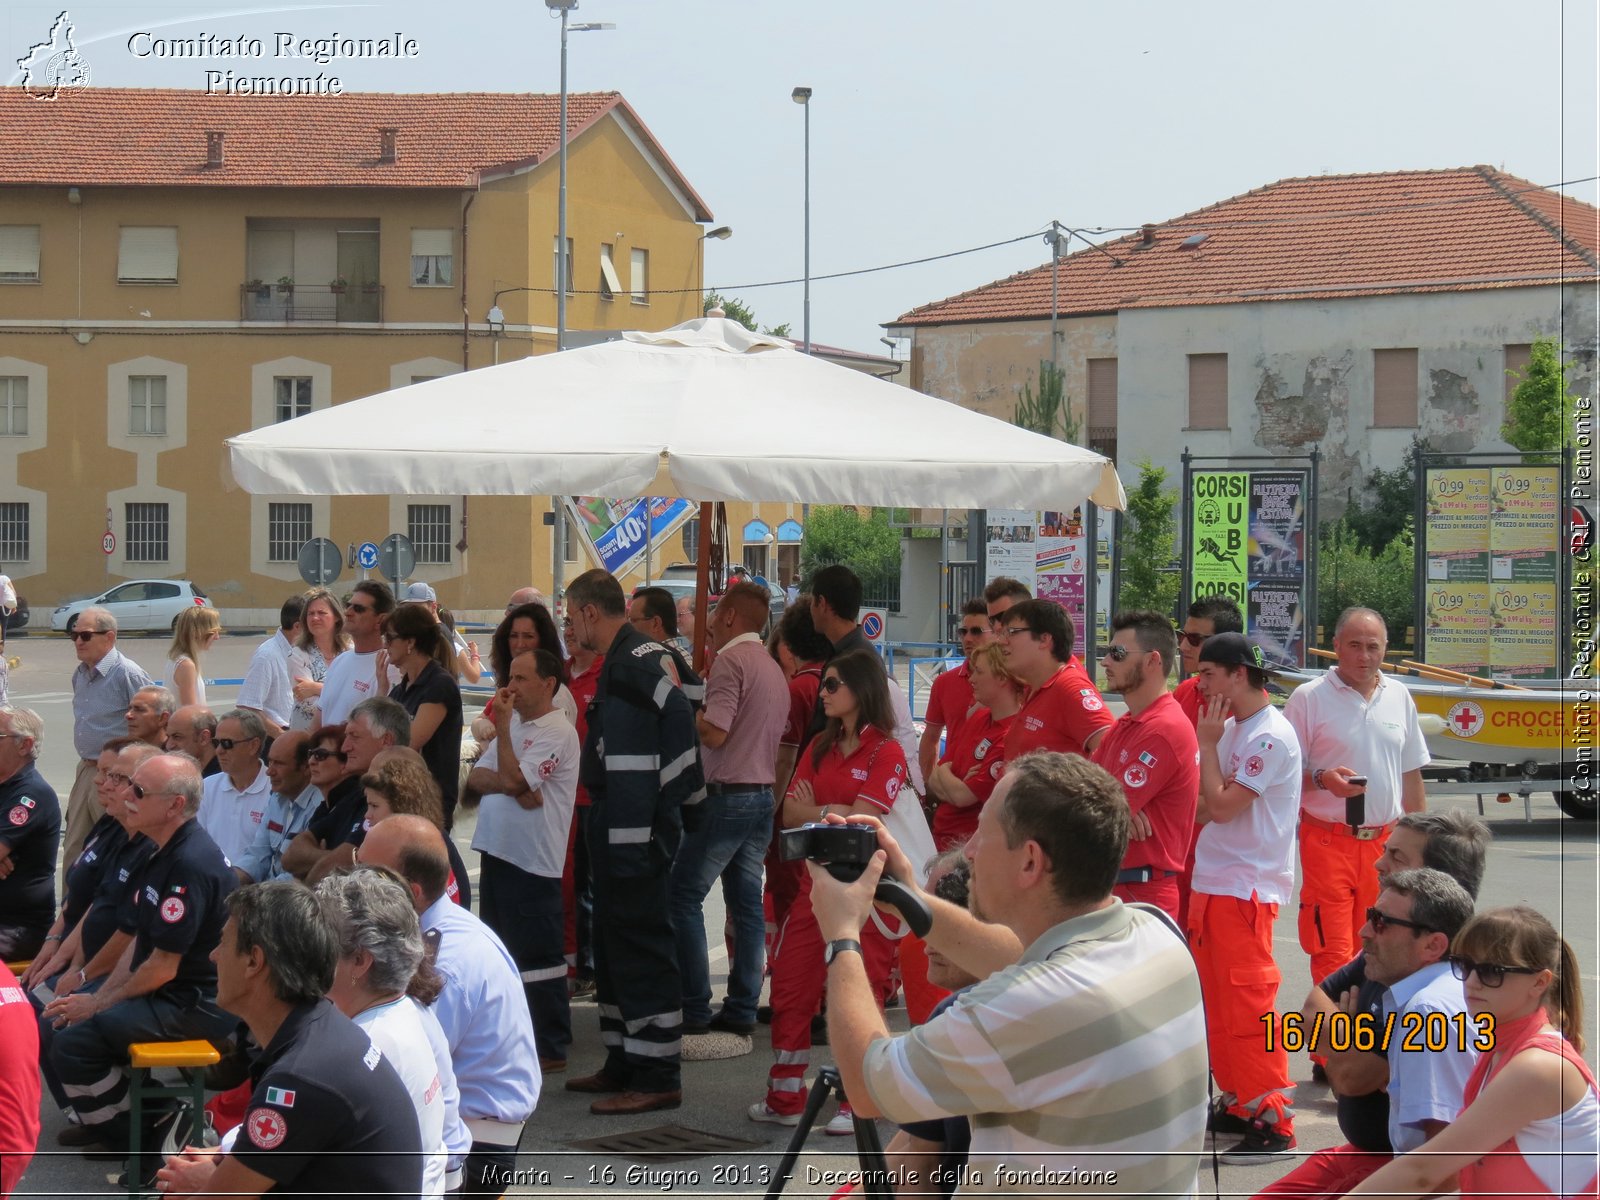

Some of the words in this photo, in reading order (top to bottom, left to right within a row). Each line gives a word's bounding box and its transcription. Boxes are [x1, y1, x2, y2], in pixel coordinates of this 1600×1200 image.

[1196, 476, 1247, 497] CORSI
[1256, 508, 1295, 520] FESTIVAL
[104, 538, 113, 549] 30
[1195, 581, 1245, 604] CORSI
[1255, 615, 1294, 627] FESTIVAL
[1491, 711, 1565, 727] CROCE
